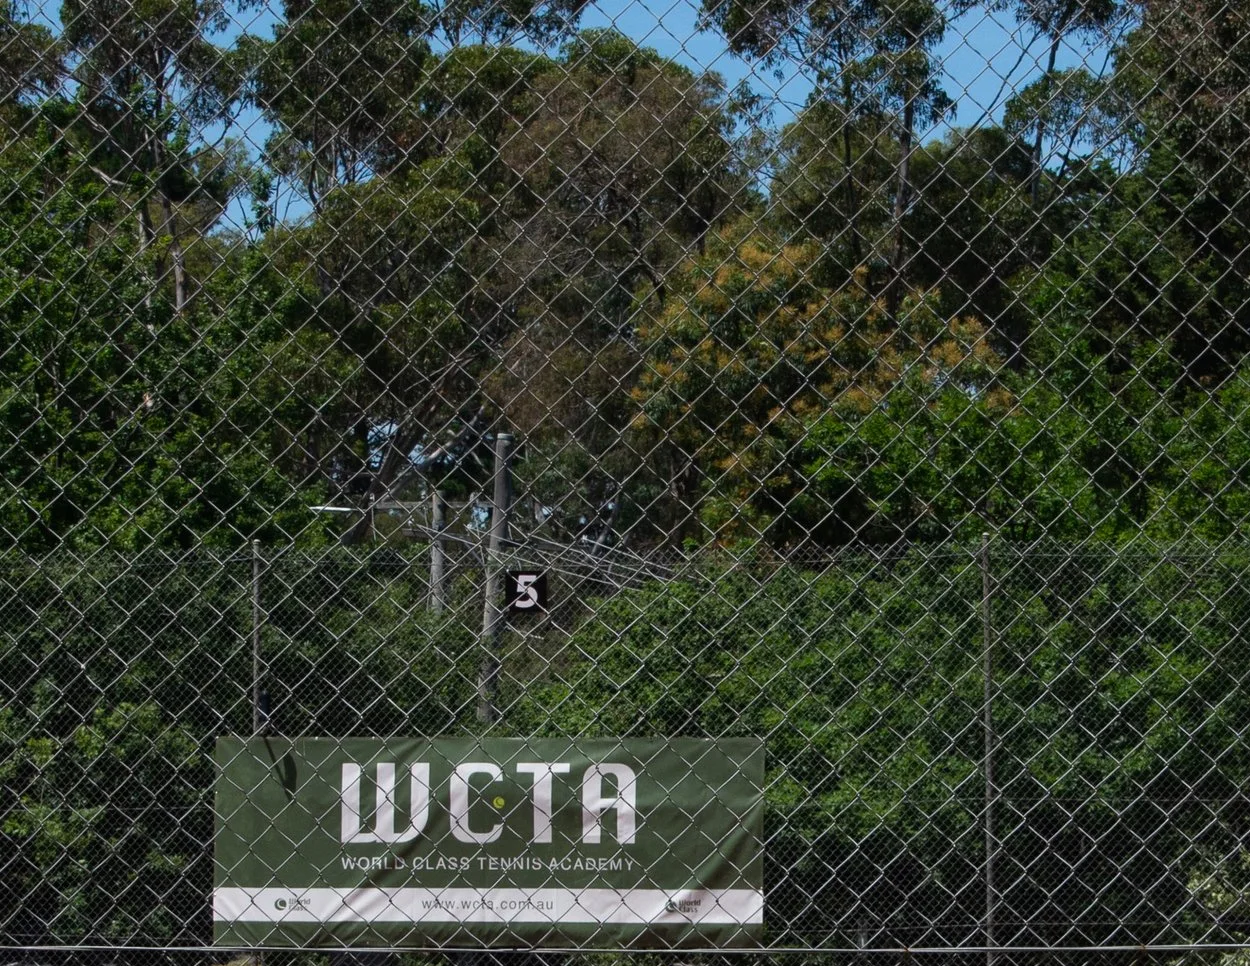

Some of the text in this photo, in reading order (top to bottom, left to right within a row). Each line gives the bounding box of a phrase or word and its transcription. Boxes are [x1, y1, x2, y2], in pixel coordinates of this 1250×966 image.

[515, 575, 538, 608] 5
[341, 762, 636, 845] WCTA
[342, 856, 635, 871] WORLD CLASS TENNIS ACADEMY
[421, 898, 554, 910] www.wcta.com.au
